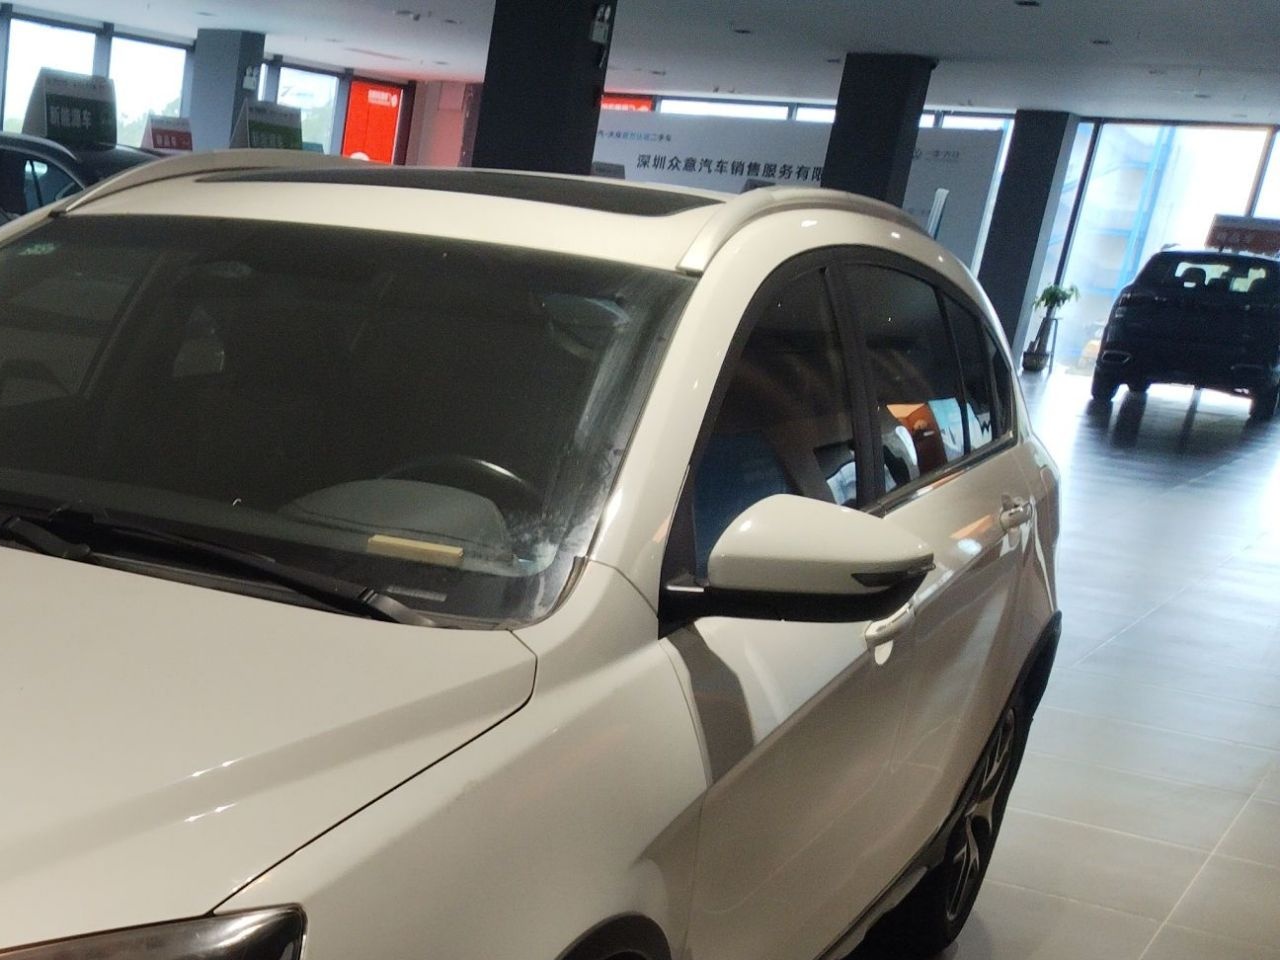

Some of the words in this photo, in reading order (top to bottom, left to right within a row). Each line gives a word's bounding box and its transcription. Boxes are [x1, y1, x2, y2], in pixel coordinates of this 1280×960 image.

[636, 153, 823, 183] 深圳众意汽车销售服务有限
